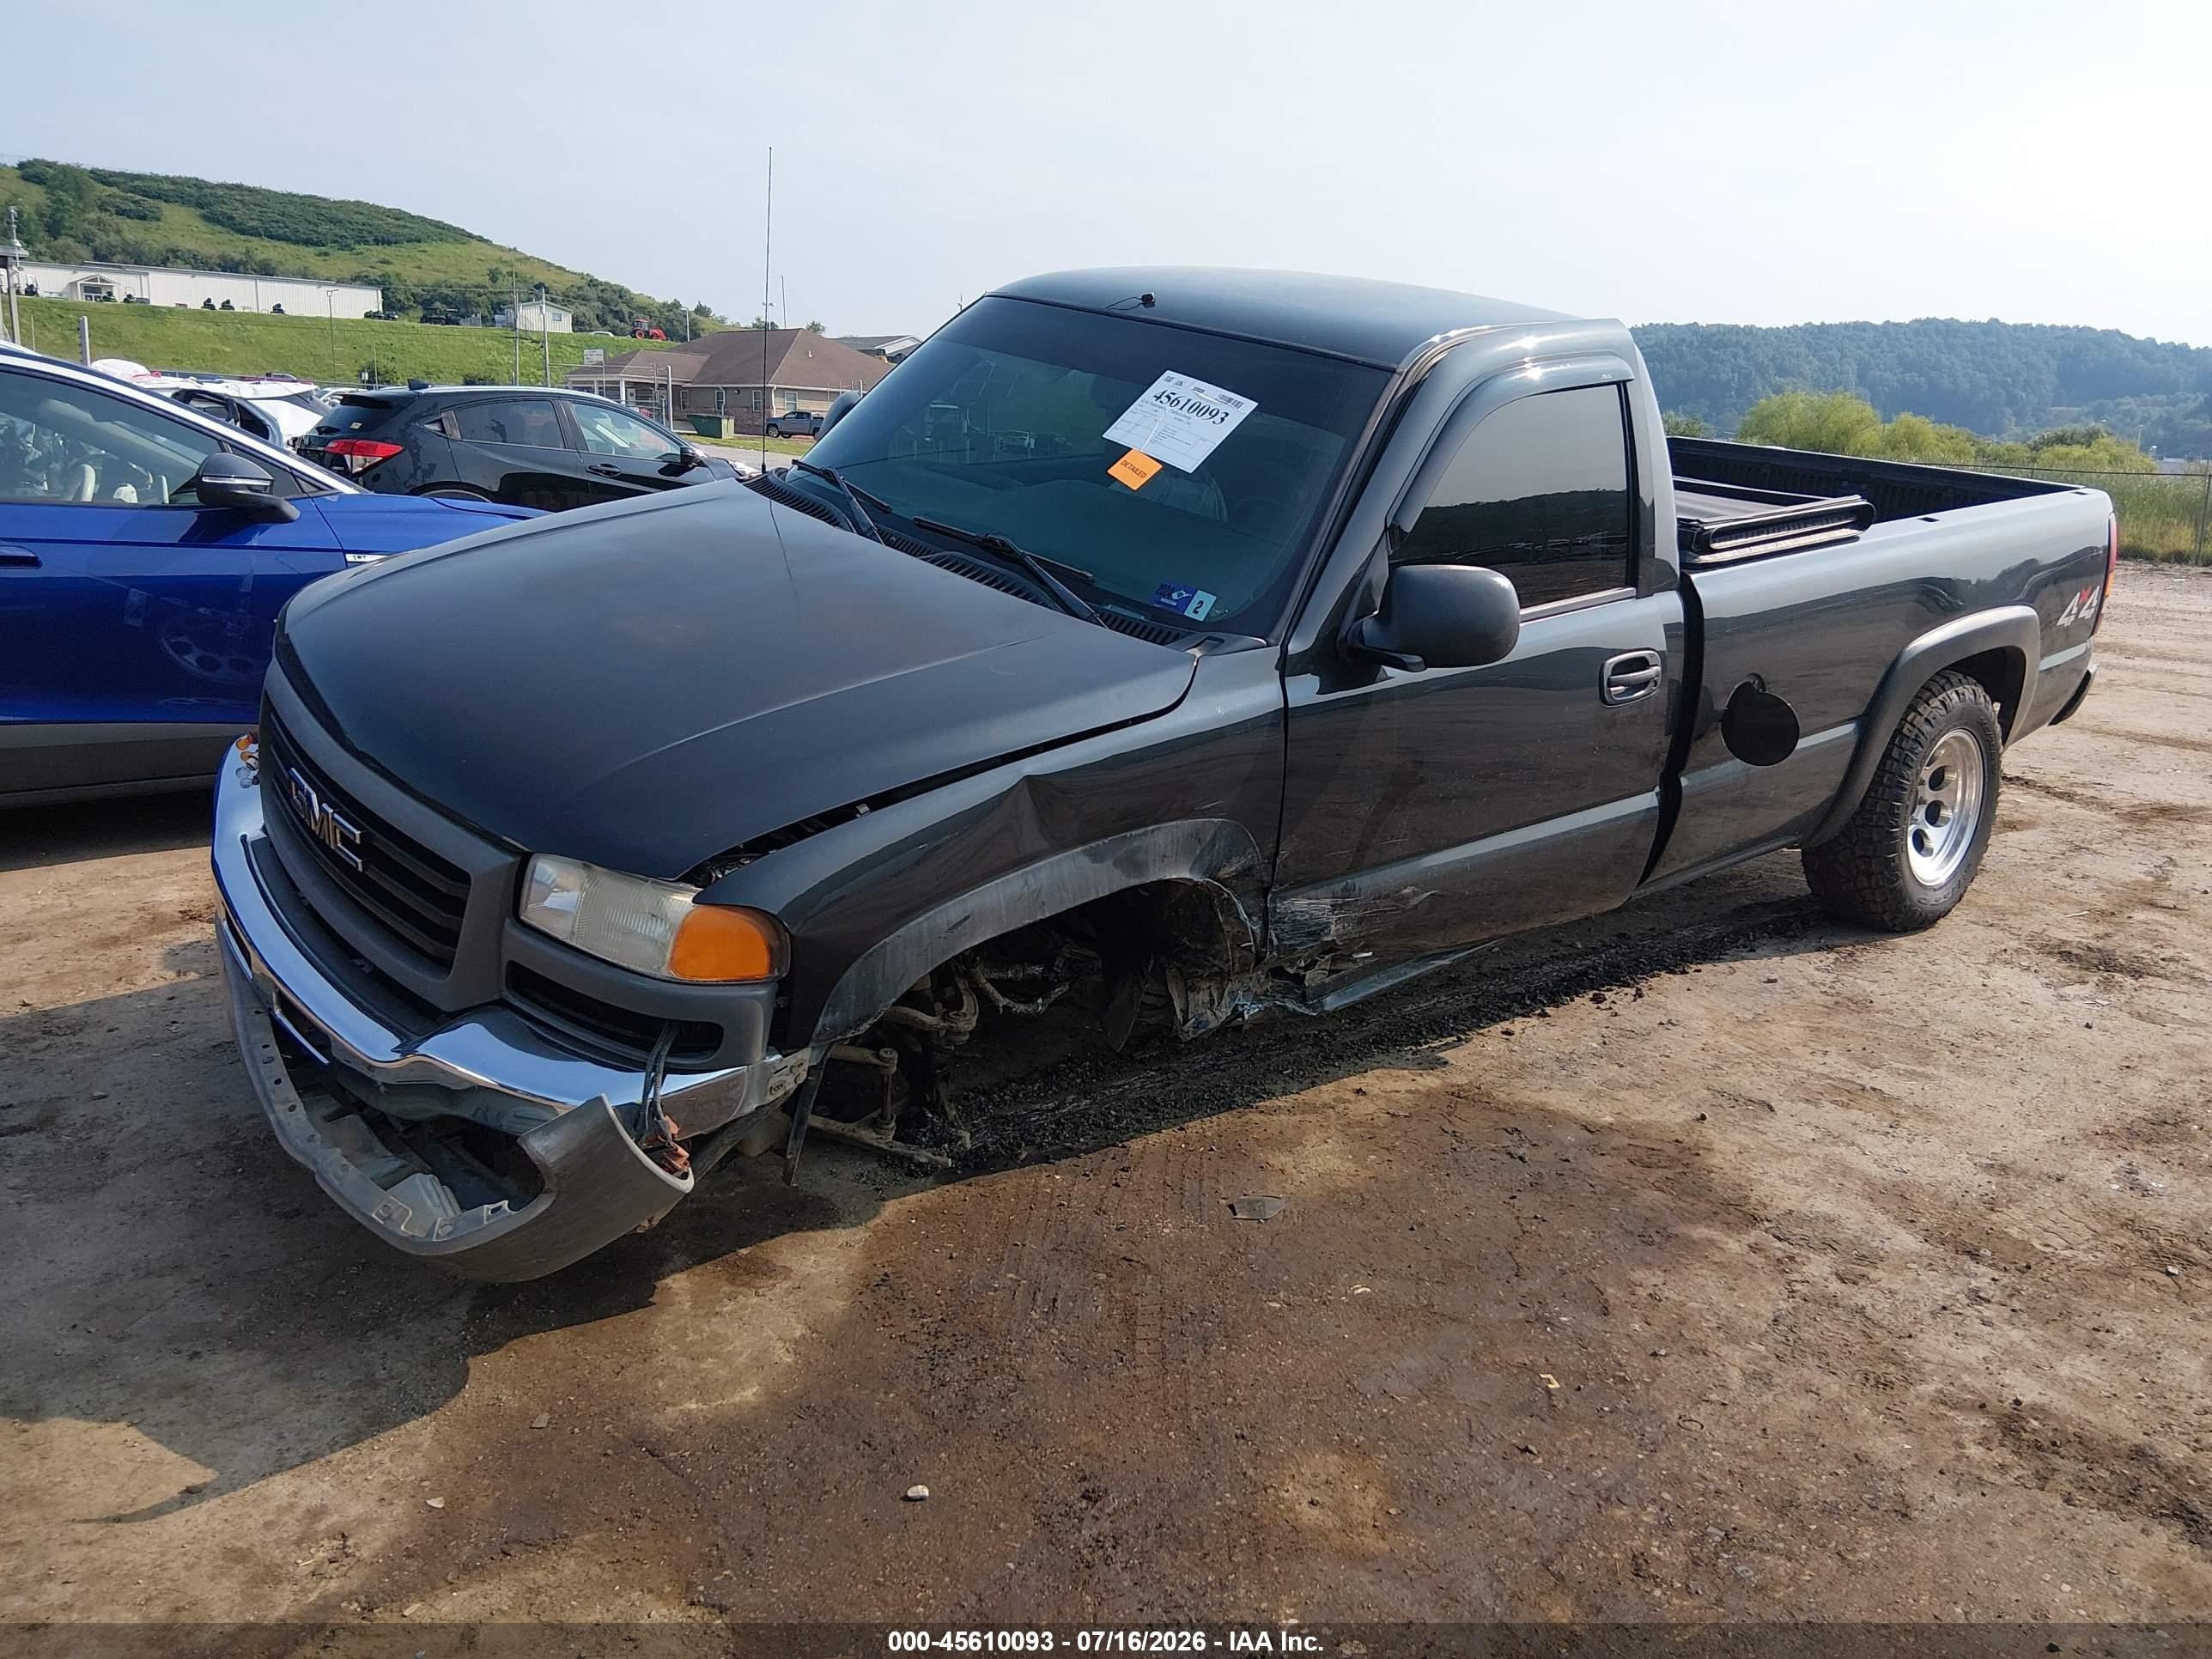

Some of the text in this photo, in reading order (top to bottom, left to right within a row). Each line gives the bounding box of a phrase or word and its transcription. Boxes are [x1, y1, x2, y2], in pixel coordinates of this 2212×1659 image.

[1153, 389, 1230, 426] 45610093
[1121, 460, 1147, 478] DETAILED
[1192, 599, 1204, 615] 2
[288, 767, 363, 873] GMC
